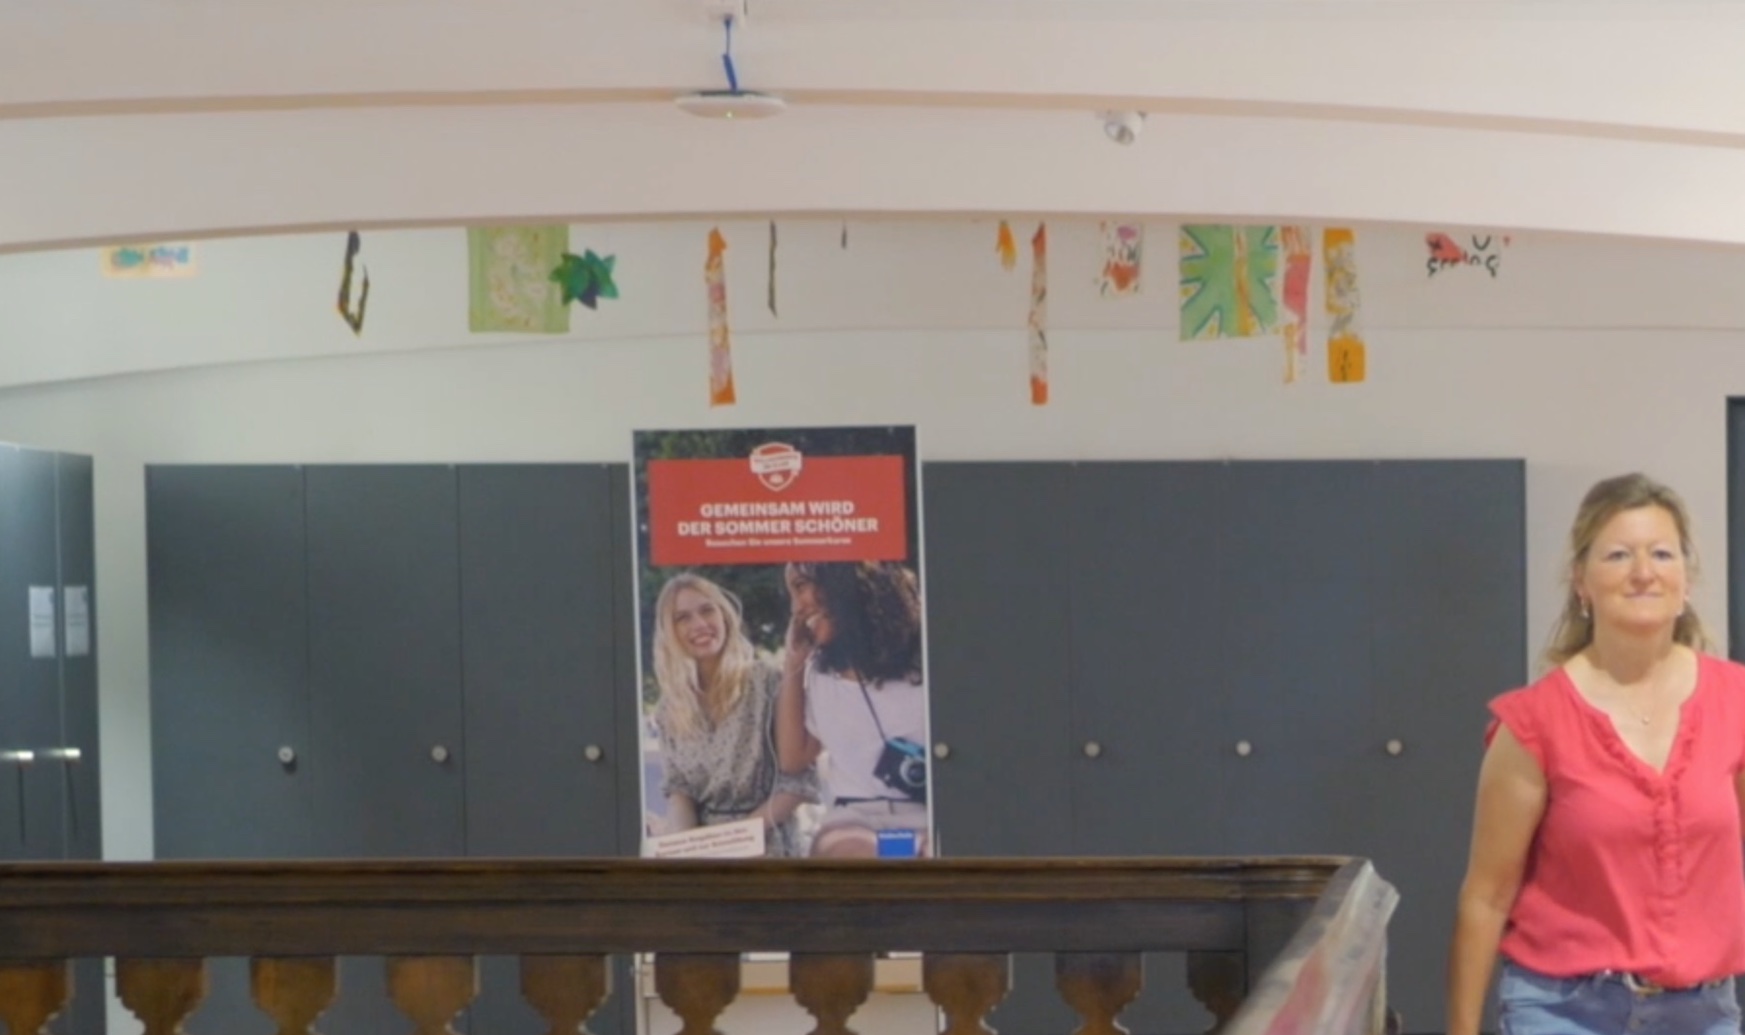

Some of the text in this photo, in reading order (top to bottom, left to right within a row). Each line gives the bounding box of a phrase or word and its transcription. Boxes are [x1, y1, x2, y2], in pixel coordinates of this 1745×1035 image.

[701, 500, 855, 518] GEMEINSAM WIRD
[677, 516, 879, 536] DER SOMMER SCHÖNER
